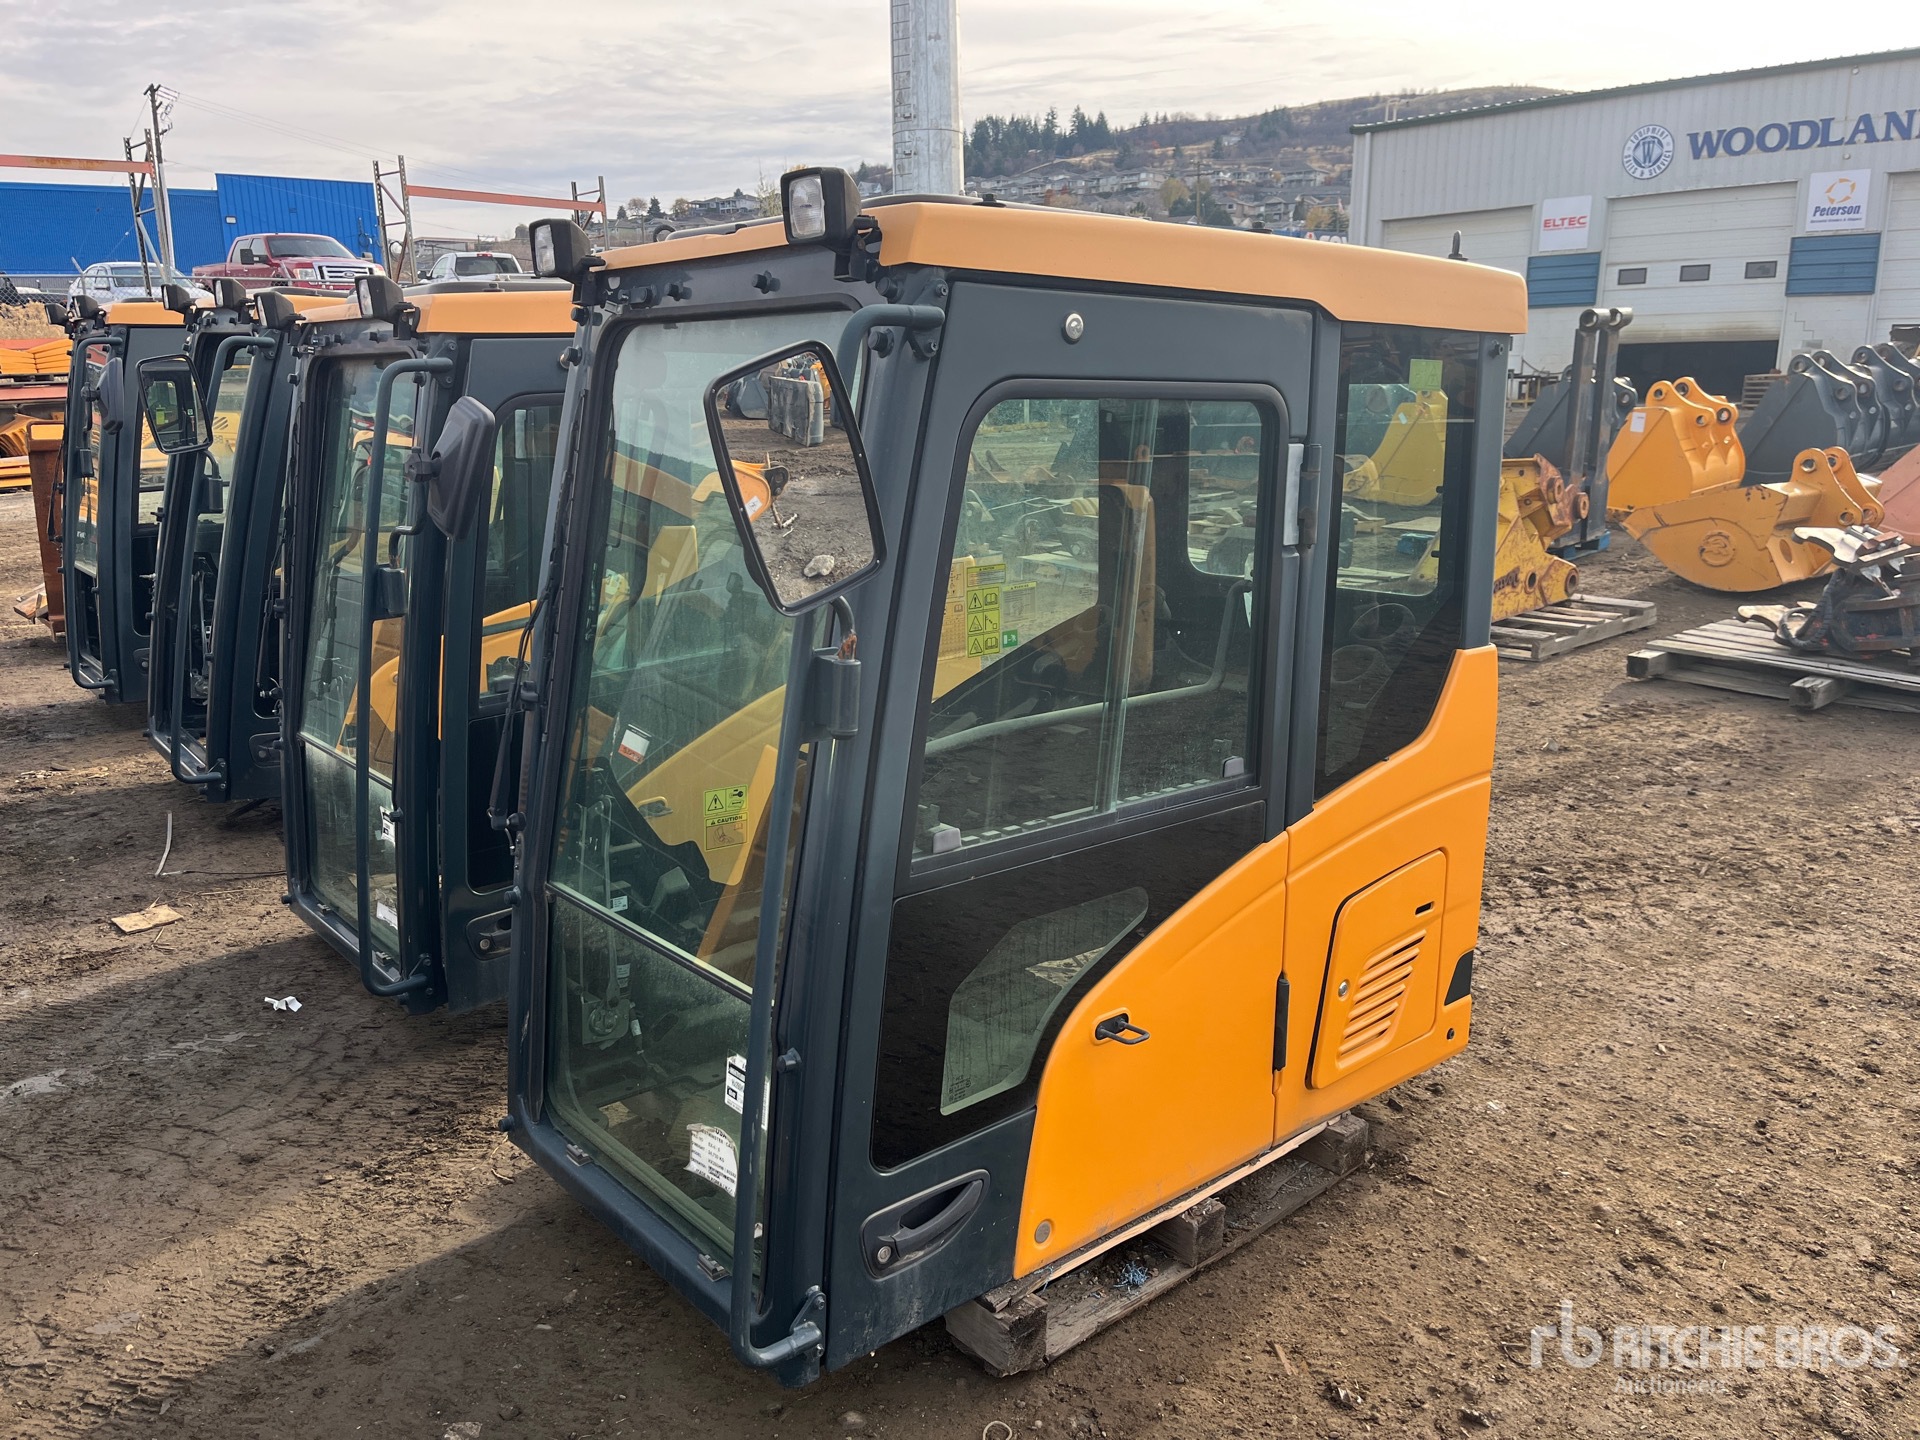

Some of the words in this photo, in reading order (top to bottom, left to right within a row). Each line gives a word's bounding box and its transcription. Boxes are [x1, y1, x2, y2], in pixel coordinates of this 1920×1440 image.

[1630, 127, 1669, 144] EQUIPMENT
[1687, 109, 1920, 160] WOODLAN
[1812, 204, 1861, 217] Peterson
[1543, 215, 1588, 229] ELTEC
[716, 814, 743, 825] CAUTION
